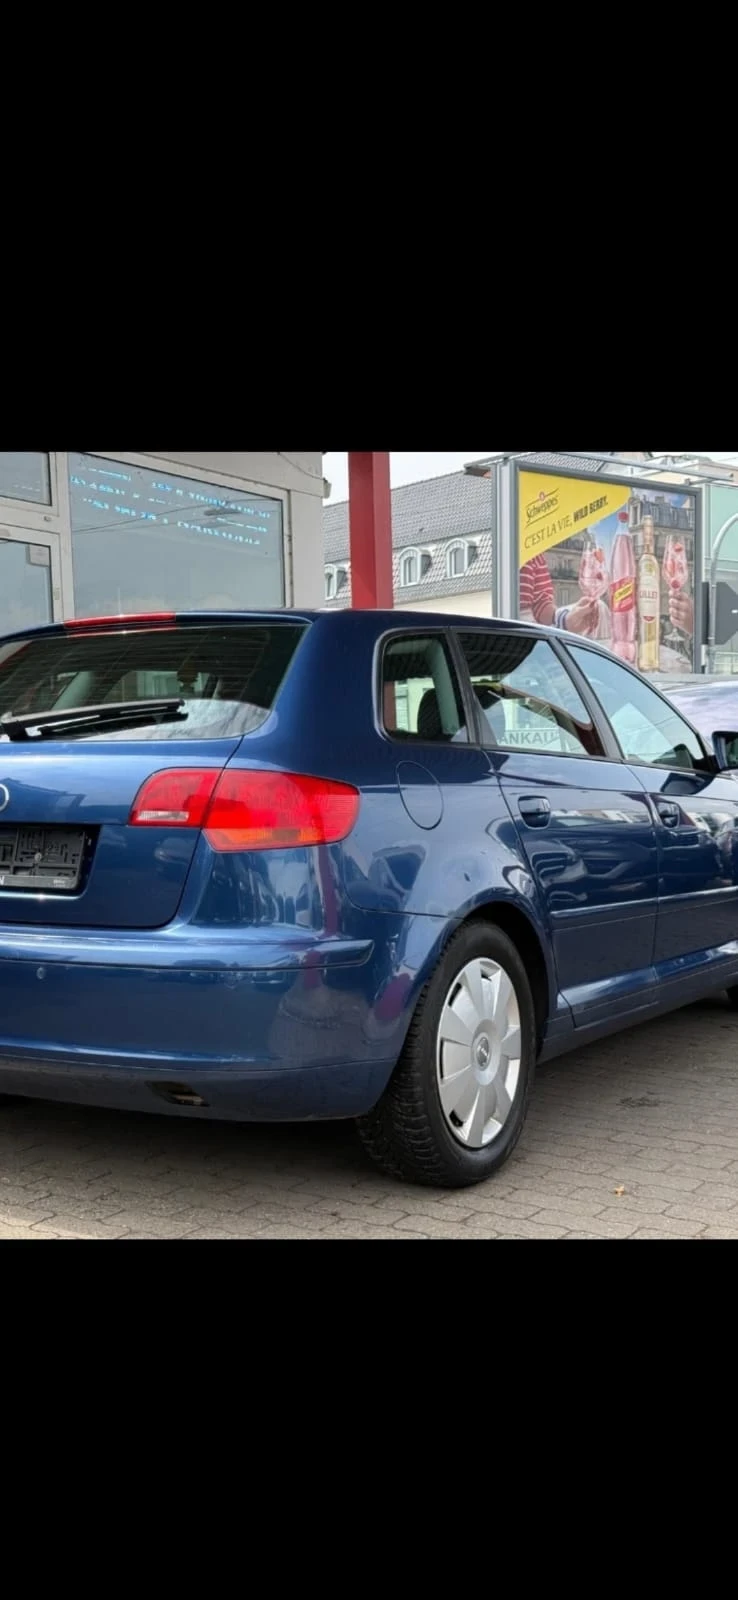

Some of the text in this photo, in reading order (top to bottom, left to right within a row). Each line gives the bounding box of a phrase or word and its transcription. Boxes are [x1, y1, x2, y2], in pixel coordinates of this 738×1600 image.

[524, 529, 546, 549] C'EST
[546, 522, 557, 538] LA
[573, 505, 588, 523] WILD
